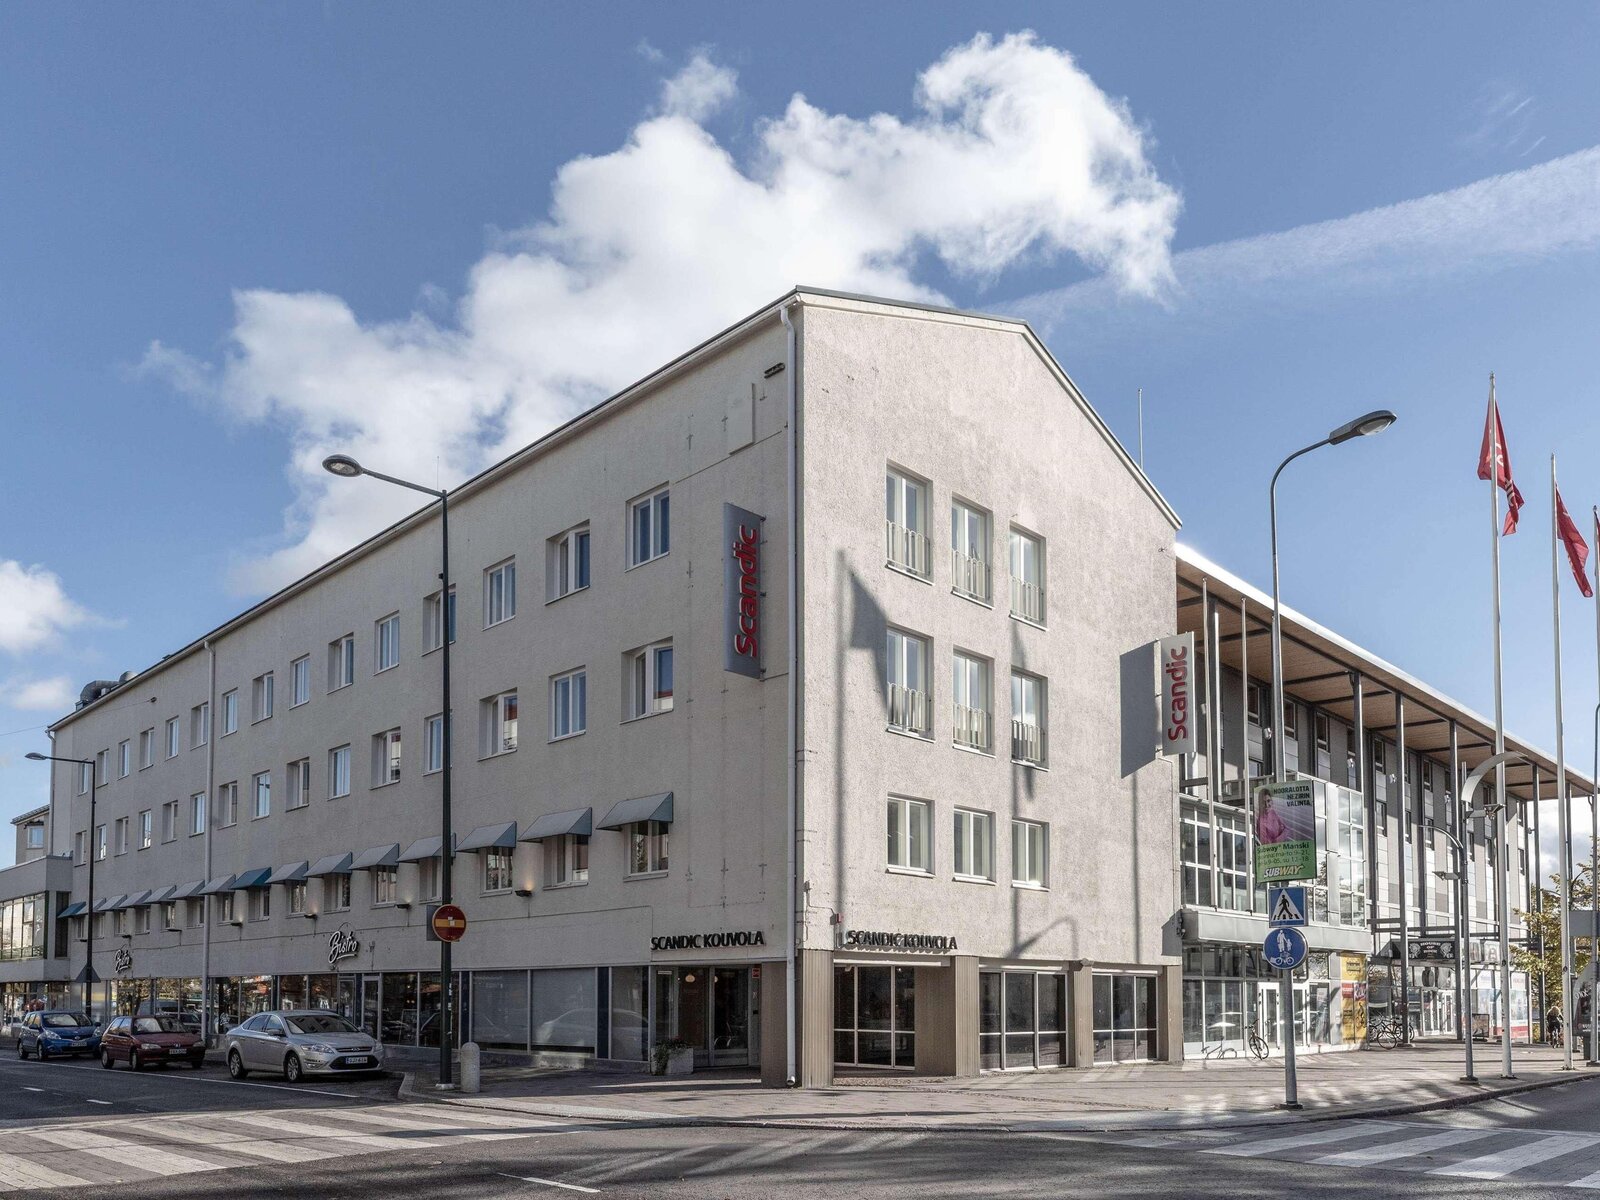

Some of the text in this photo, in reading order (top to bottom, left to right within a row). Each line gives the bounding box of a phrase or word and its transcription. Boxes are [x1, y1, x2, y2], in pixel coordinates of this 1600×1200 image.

[733, 525, 757, 658] Scandic
[1166, 646, 1188, 742] Scandic
[1282, 842, 1310, 850] Manski
[1263, 865, 1303, 878] SUBWAY
[328, 931, 357, 964] Bistro
[651, 931, 764, 950] SCANDIC KOUVOLA
[847, 930, 957, 949] SCANDIC KOUVOLA
